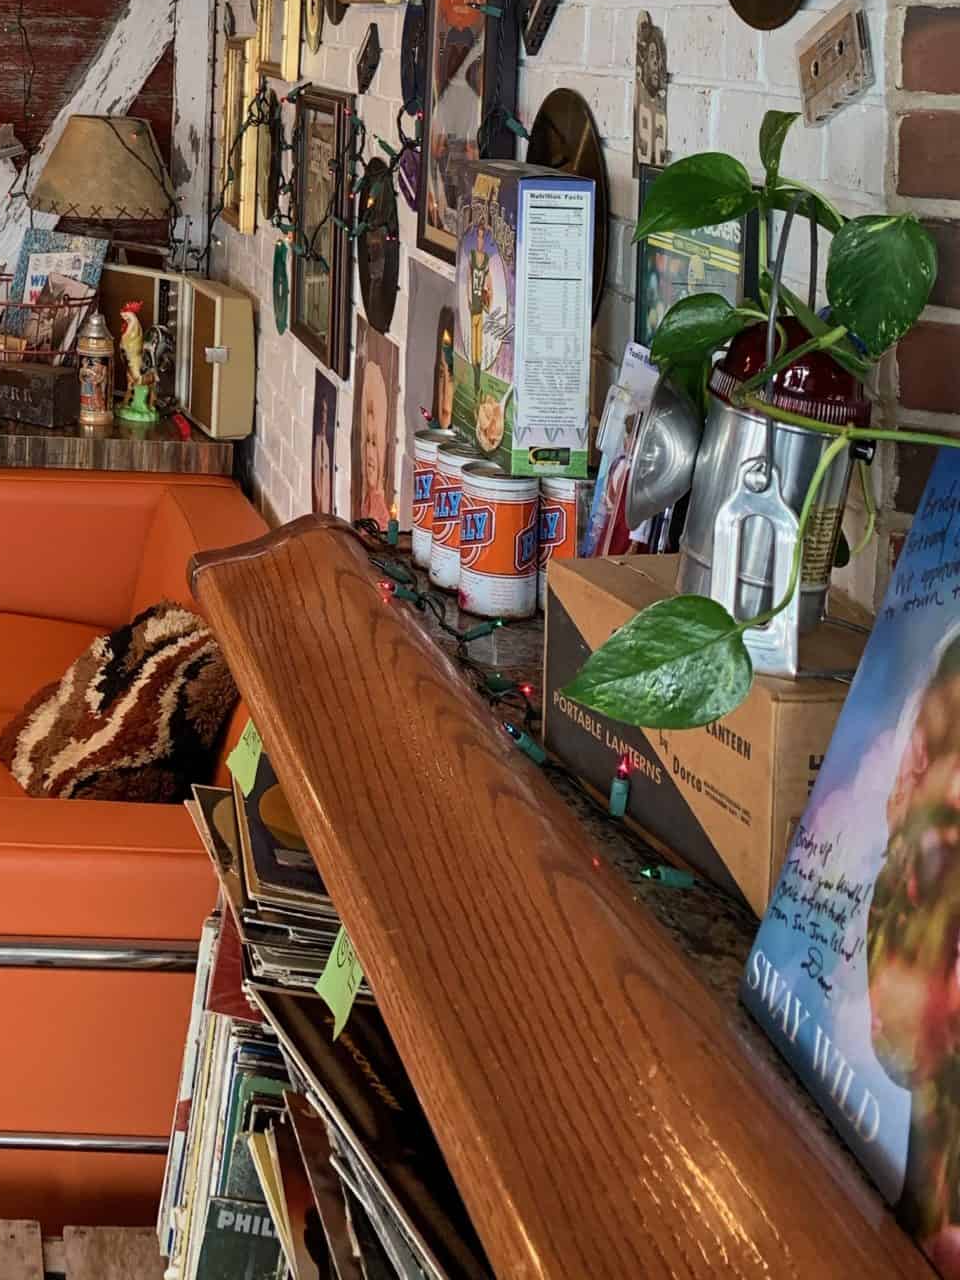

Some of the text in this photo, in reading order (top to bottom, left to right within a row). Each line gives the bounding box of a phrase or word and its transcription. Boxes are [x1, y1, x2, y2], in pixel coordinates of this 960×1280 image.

[553, 690, 663, 786] PORTABLE LANTERNS
[672, 756, 703, 794] Dorco
[749, 950, 882, 1143] SWAY WILD
